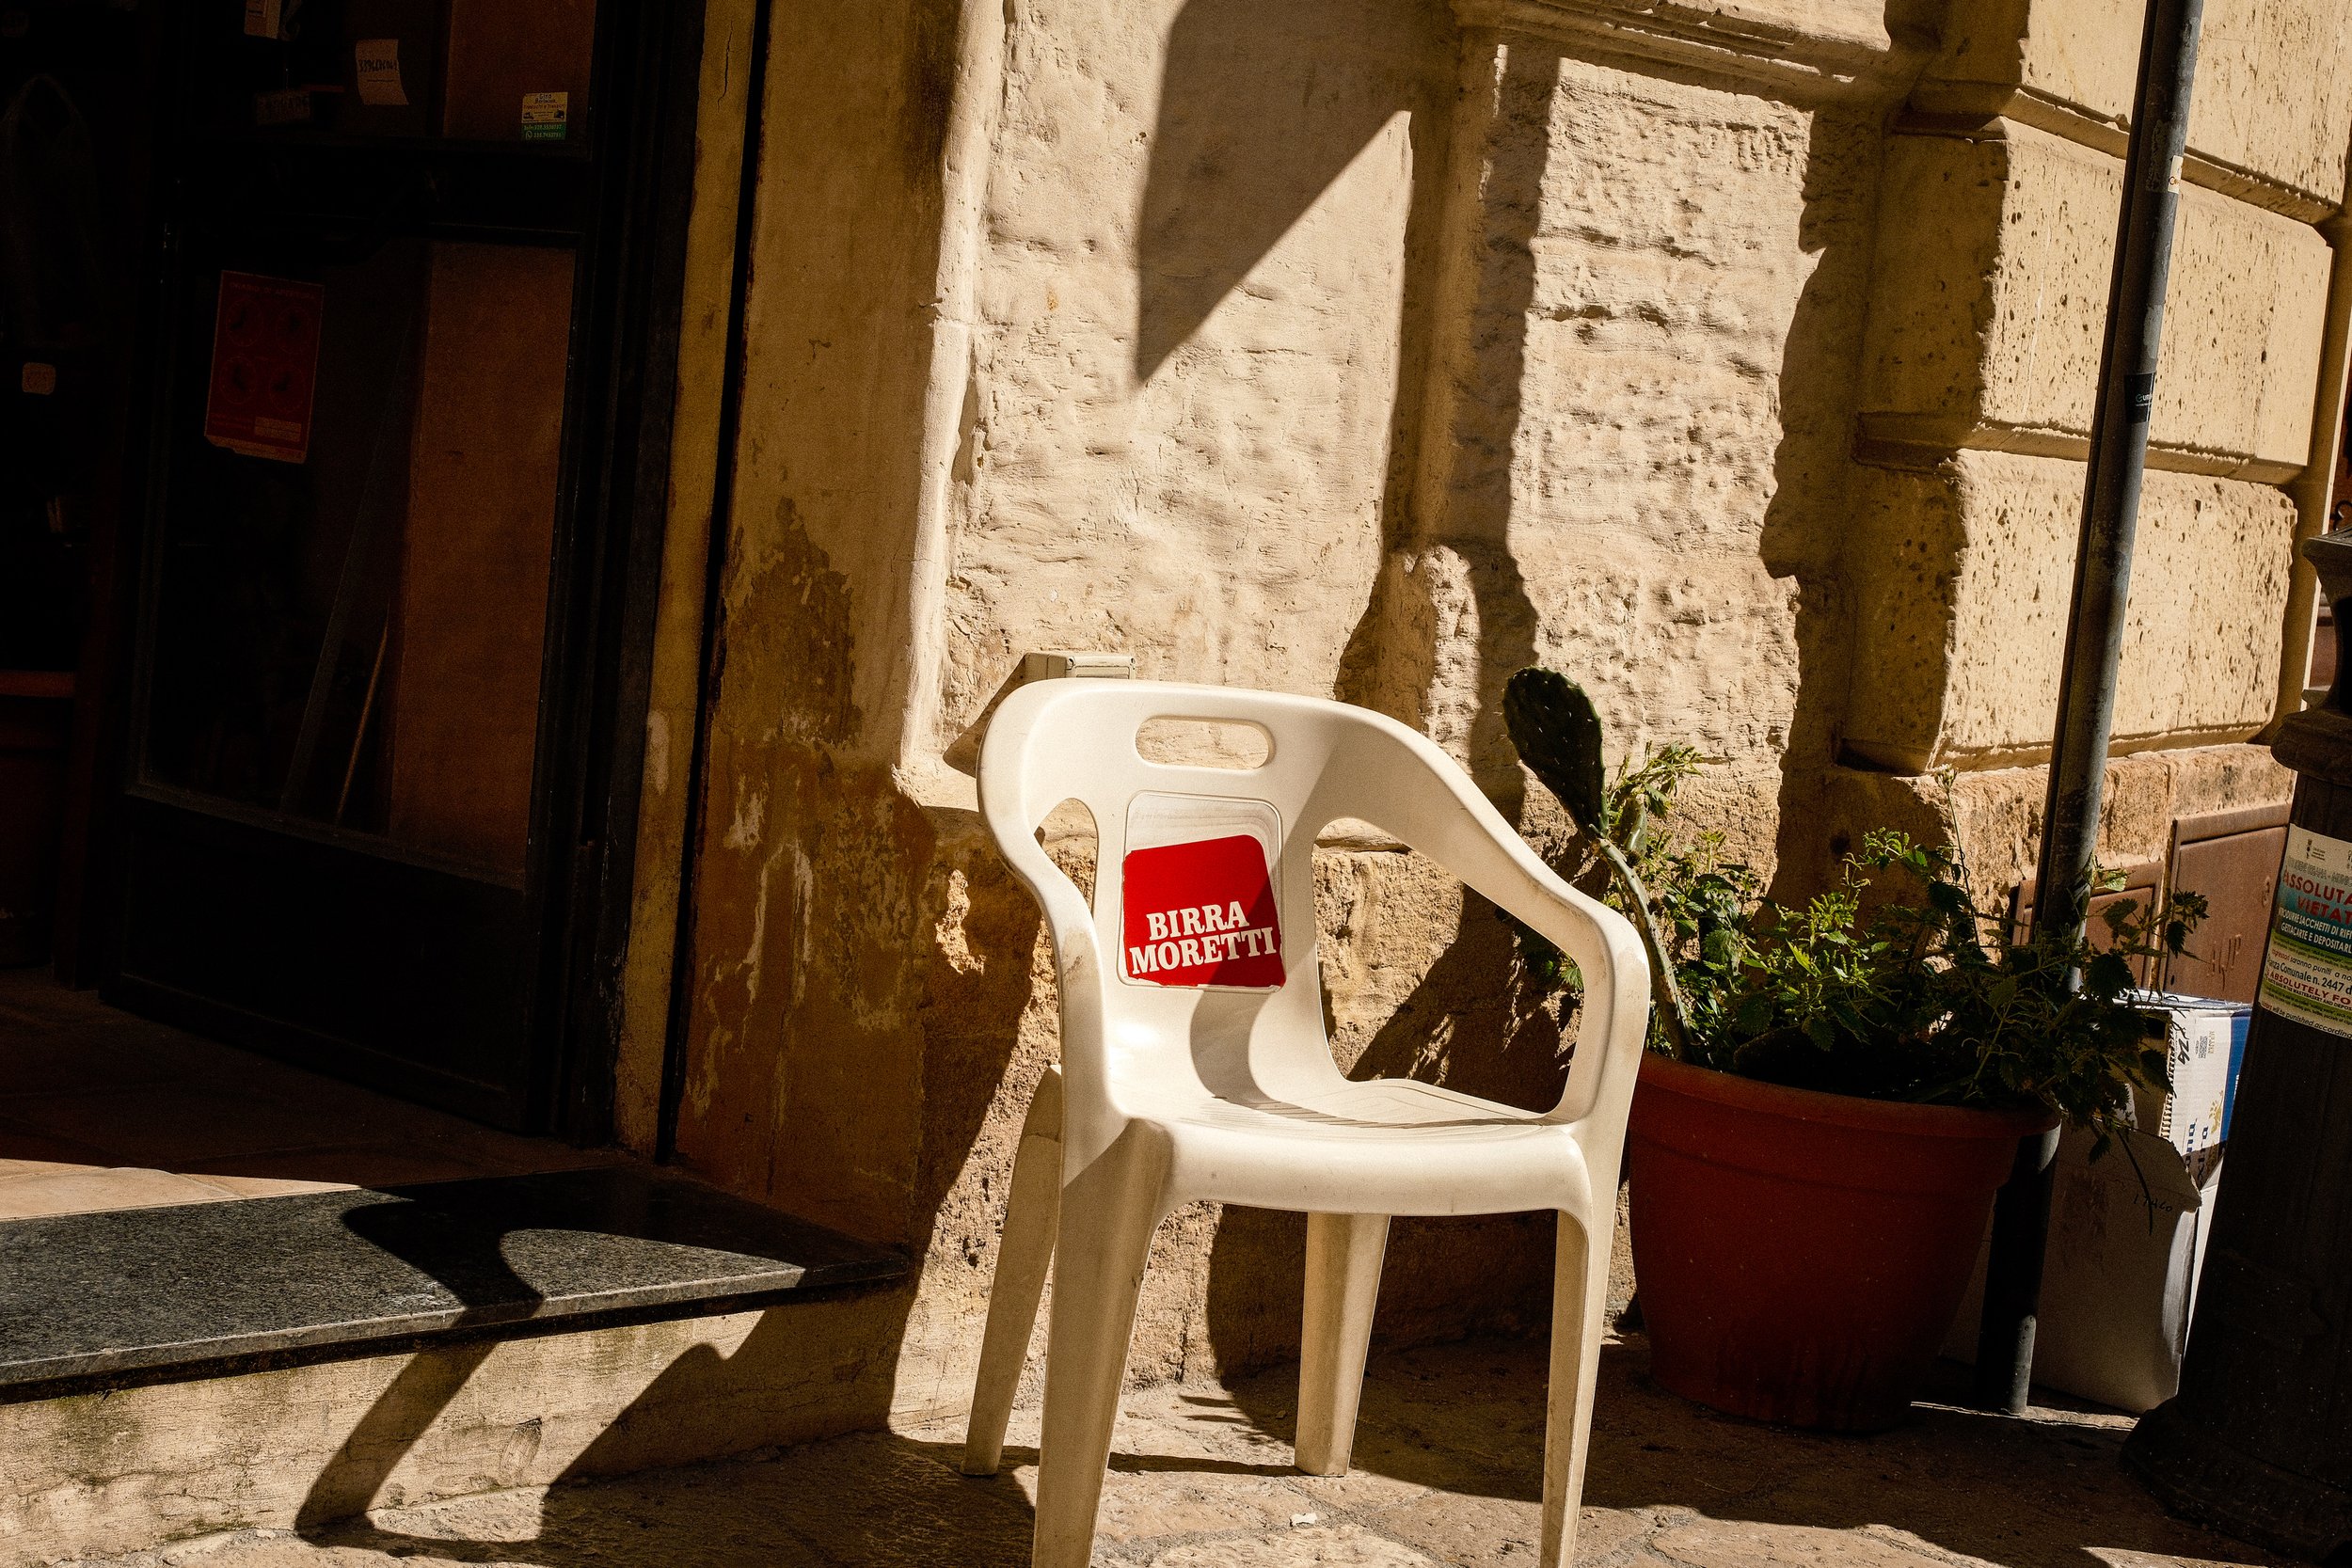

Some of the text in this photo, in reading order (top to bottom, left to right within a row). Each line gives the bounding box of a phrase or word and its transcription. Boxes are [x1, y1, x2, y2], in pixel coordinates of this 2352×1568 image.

[1146, 900, 1250, 942] BIRRA
[2330, 924, 2339, 936] DI
[1128, 927, 1278, 974] MORETTI
[2308, 931, 2314, 942] E
[2270, 971, 2329, 999] ABSOLUTELY
[2280, 961, 2312, 983] Comunale
[2322, 977, 2345, 993] 2447
[2285, 1012, 2314, 1026] punished
